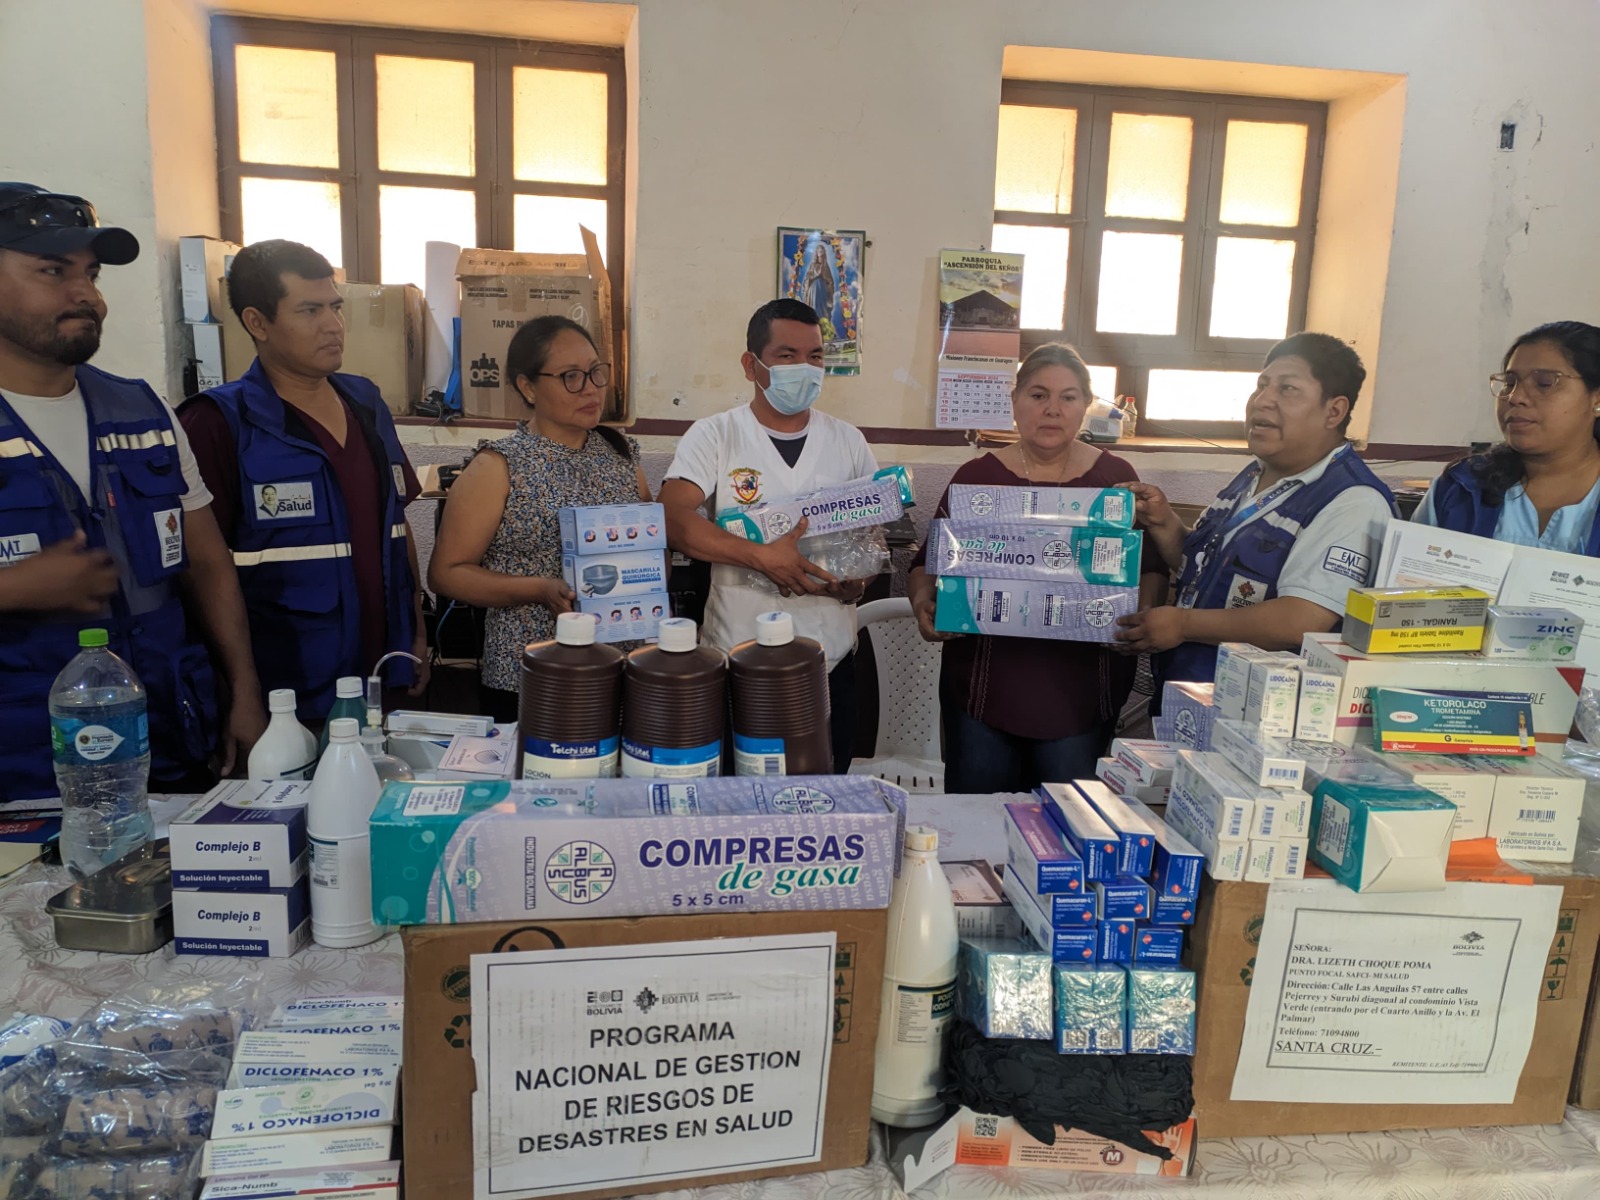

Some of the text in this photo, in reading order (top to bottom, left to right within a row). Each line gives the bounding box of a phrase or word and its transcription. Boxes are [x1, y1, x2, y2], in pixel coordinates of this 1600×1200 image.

[962, 256, 1002, 264] PARROQUIA
[492, 320, 515, 328] TAPAS
[470, 369, 499, 382] OPS
[279, 500, 312, 512] Salud
[801, 494, 881, 517] COMPRESAS
[831, 507, 881, 523] de gasa
[989, 540, 1006, 554] de
[947, 550, 1035, 565] COMPRESAS
[1424, 618, 1457, 626] RANIGAL
[1537, 625, 1575, 633] ZINC
[1424, 699, 1486, 709] KETOROLACO
[1431, 708, 1481, 716] TROMETAMINA
[195, 841, 261, 853] Complejo B
[639, 834, 865, 868] COMPRESAS
[180, 874, 263, 883] Solución Inyectable
[526, 838, 535, 909] INDUSTRIA BOLIVIANA
[549, 867, 613, 879] ALBUS
[574, 847, 588, 899] ALBUS
[718, 862, 860, 897] de gasa
[672, 893, 744, 906] 5 x 5 cm
[197, 910, 261, 923] Complejo B
[182, 941, 263, 951] Solución Inyectable
[1293, 943, 1332, 952] SEÑORA:
[1291, 956, 1432, 969] DRA. LIZETH CHOQUE POMA
[1289, 968, 1316, 976] PUNTO
[1287, 980, 1330, 989] Dirección:
[1331, 982, 1353, 991] Calle
[1356, 983, 1371, 991] Las
[1372, 985, 1409, 994] Anguilas
[1411, 985, 1421, 993] 57
[1446, 987, 1468, 995] calles
[661, 994, 699, 1004] BOLIVIA
[1285, 991, 1321, 1002] Pejerrey
[1361, 995, 1398, 1005] diagonal
[1399, 996, 1407, 1004] al
[1409, 997, 1456, 1006] condominio
[1459, 998, 1478, 1006] Vista
[287, 1002, 387, 1010] DICLOFENACO
[587, 1008, 623, 1016] BOLIVIA
[1283, 1003, 1309, 1012] Verde
[1310, 1004, 1352, 1013] (entrando
[1354, 1007, 1369, 1015] por
[1371, 1006, 1378, 1014] el
[1380, 1006, 1409, 1015] Cuarto
[1412, 1008, 1436, 1016] Anillo
[1437, 1010, 1443, 1018] y
[1455, 1009, 1468, 1017] Av.
[1470, 1009, 1480, 1017] El
[1280, 1013, 1316, 1023] Palmar)
[380, 1023, 400, 1032] 1%
[1279, 1026, 1360, 1038] Teléfono: 71094800
[590, 1021, 735, 1049] PROGRAMA
[1274, 1040, 1383, 1055] SANTA CRUZ.-
[245, 1067, 384, 1076] DICLOFENACO 1%
[516, 1050, 801, 1091] NACIONAL DE GESTION
[565, 1083, 754, 1120] DE RIESGOS DE
[262, 1108, 380, 1130] DICLOFENACO
[232, 1121, 255, 1133] 1%
[518, 1109, 793, 1154] DESASTRES EN SALUD
[1106, 1151, 1121, 1162] M
[211, 1181, 279, 1193] Sica-Numb
